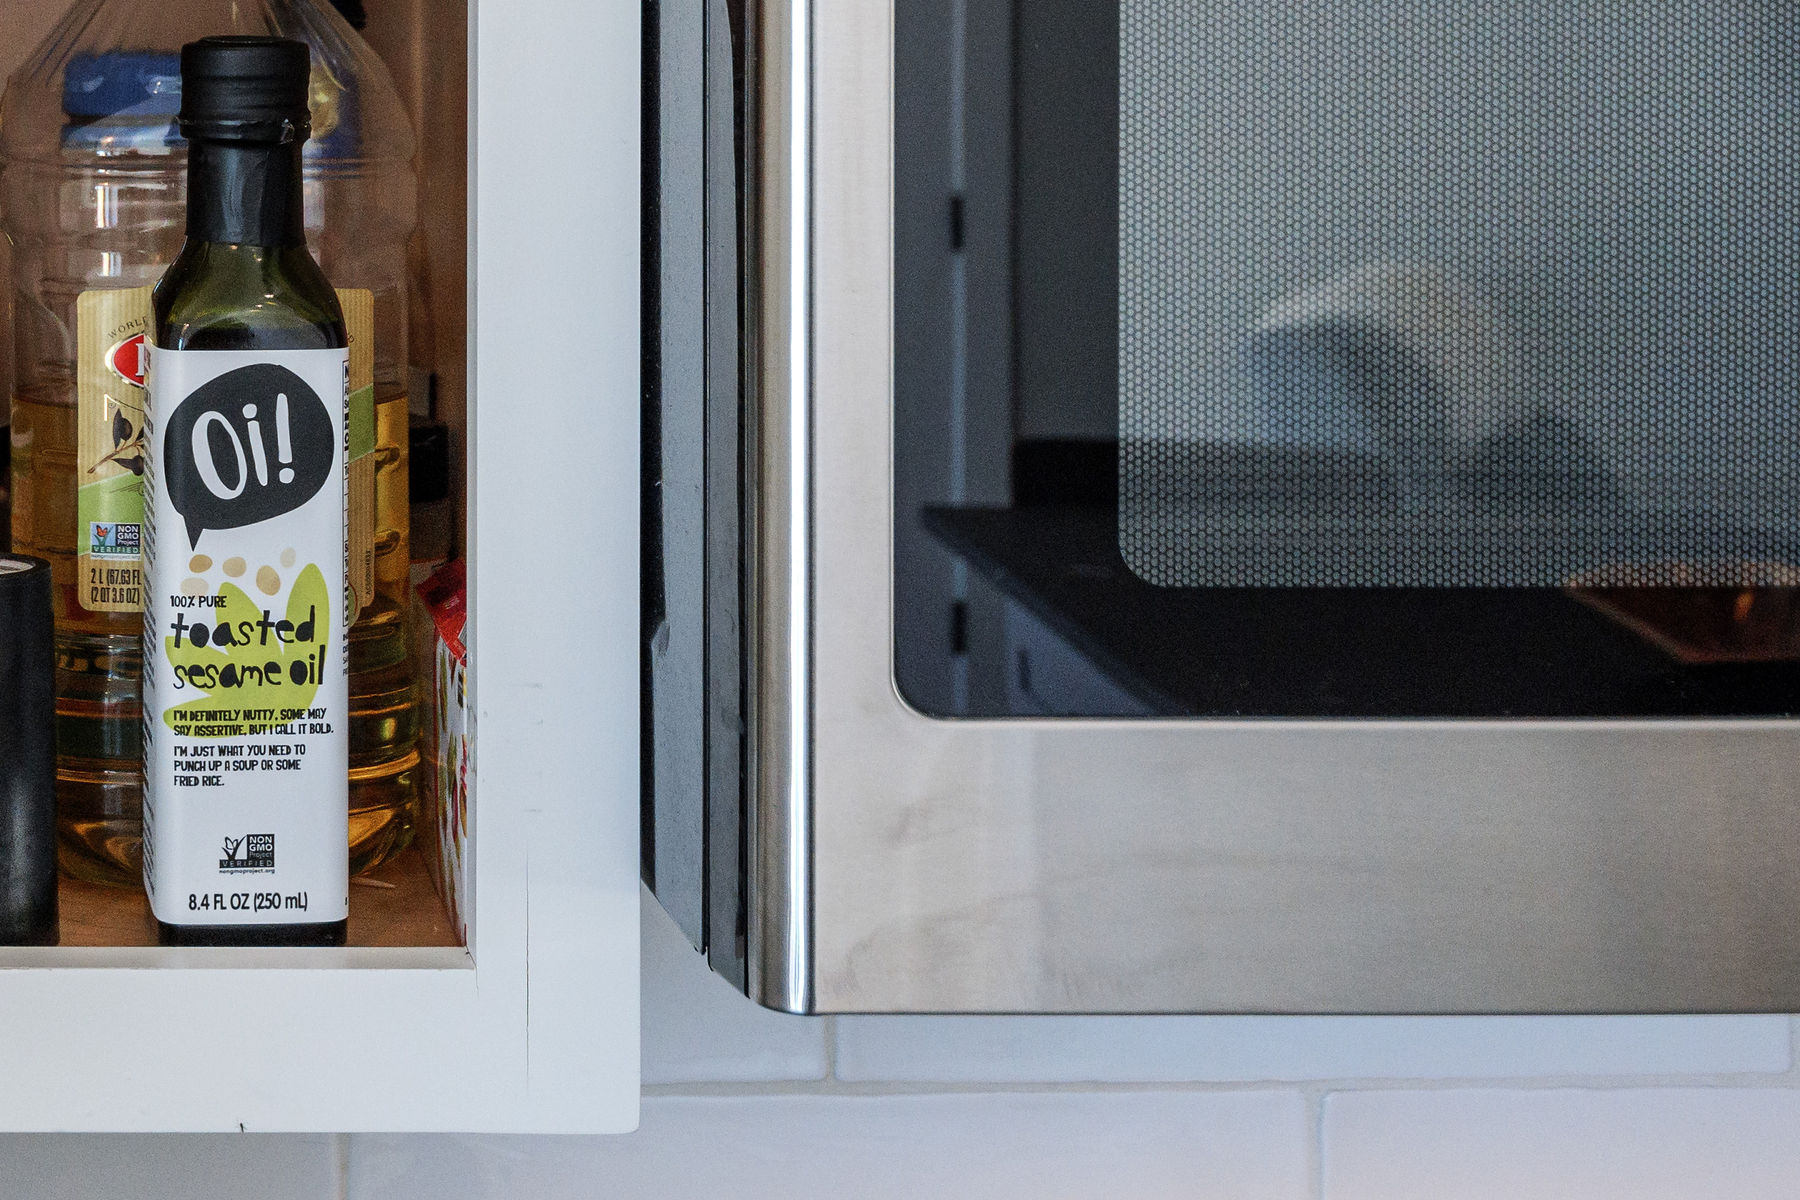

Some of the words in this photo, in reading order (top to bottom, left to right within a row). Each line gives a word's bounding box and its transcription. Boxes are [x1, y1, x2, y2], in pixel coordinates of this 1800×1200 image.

[192, 392, 292, 500] Oi!
[118, 525, 138, 533] NON
[91, 568, 95, 583] 2
[100, 569, 103, 584] L
[107, 569, 130, 586] (67.63
[133, 570, 141, 585] FL
[91, 587, 98, 604] (2
[101, 588, 110, 602] QT
[112, 588, 124, 603] 3.6
[126, 588, 140, 605] OZ)
[170, 596, 195, 608] 100%
[199, 595, 227, 608] PURE
[171, 605, 315, 648] toasted
[173, 661, 281, 689] sesame
[290, 645, 325, 685] oil
[174, 710, 187, 721] I'M
[190, 709, 240, 721] DEFINITELY
[243, 709, 278, 721] NUTTY,
[280, 709, 305, 720] SOME
[308, 708, 327, 719] MAY
[174, 725, 190, 736] SAY
[194, 725, 247, 736] ASSERTIVE,
[250, 724, 267, 735] BUT
[275, 724, 296, 734] CALL
[299, 724, 308, 734] IT
[310, 723, 334, 734] BOLD.
[174, 746, 187, 757] I'M
[190, 746, 215, 756] JUST
[218, 746, 244, 756] WHAT
[247, 745, 267, 756] YOU
[269, 745, 291, 755] NEED
[294, 744, 305, 755] TO
[174, 760, 206, 771] PUNCH
[209, 760, 222, 771] UP
[225, 760, 230, 771] A
[233, 760, 258, 771] SOUP
[261, 760, 273, 770] OR
[276, 760, 301, 770] SOME
[174, 776, 199, 786] FRIED
[202, 776, 224, 786] RICE.
[189, 894, 210, 910] 8.4
[214, 894, 227, 910] FL
[230, 893, 250, 910] OZ
[254, 892, 280, 912] (250
[285, 892, 307, 912] mL)
